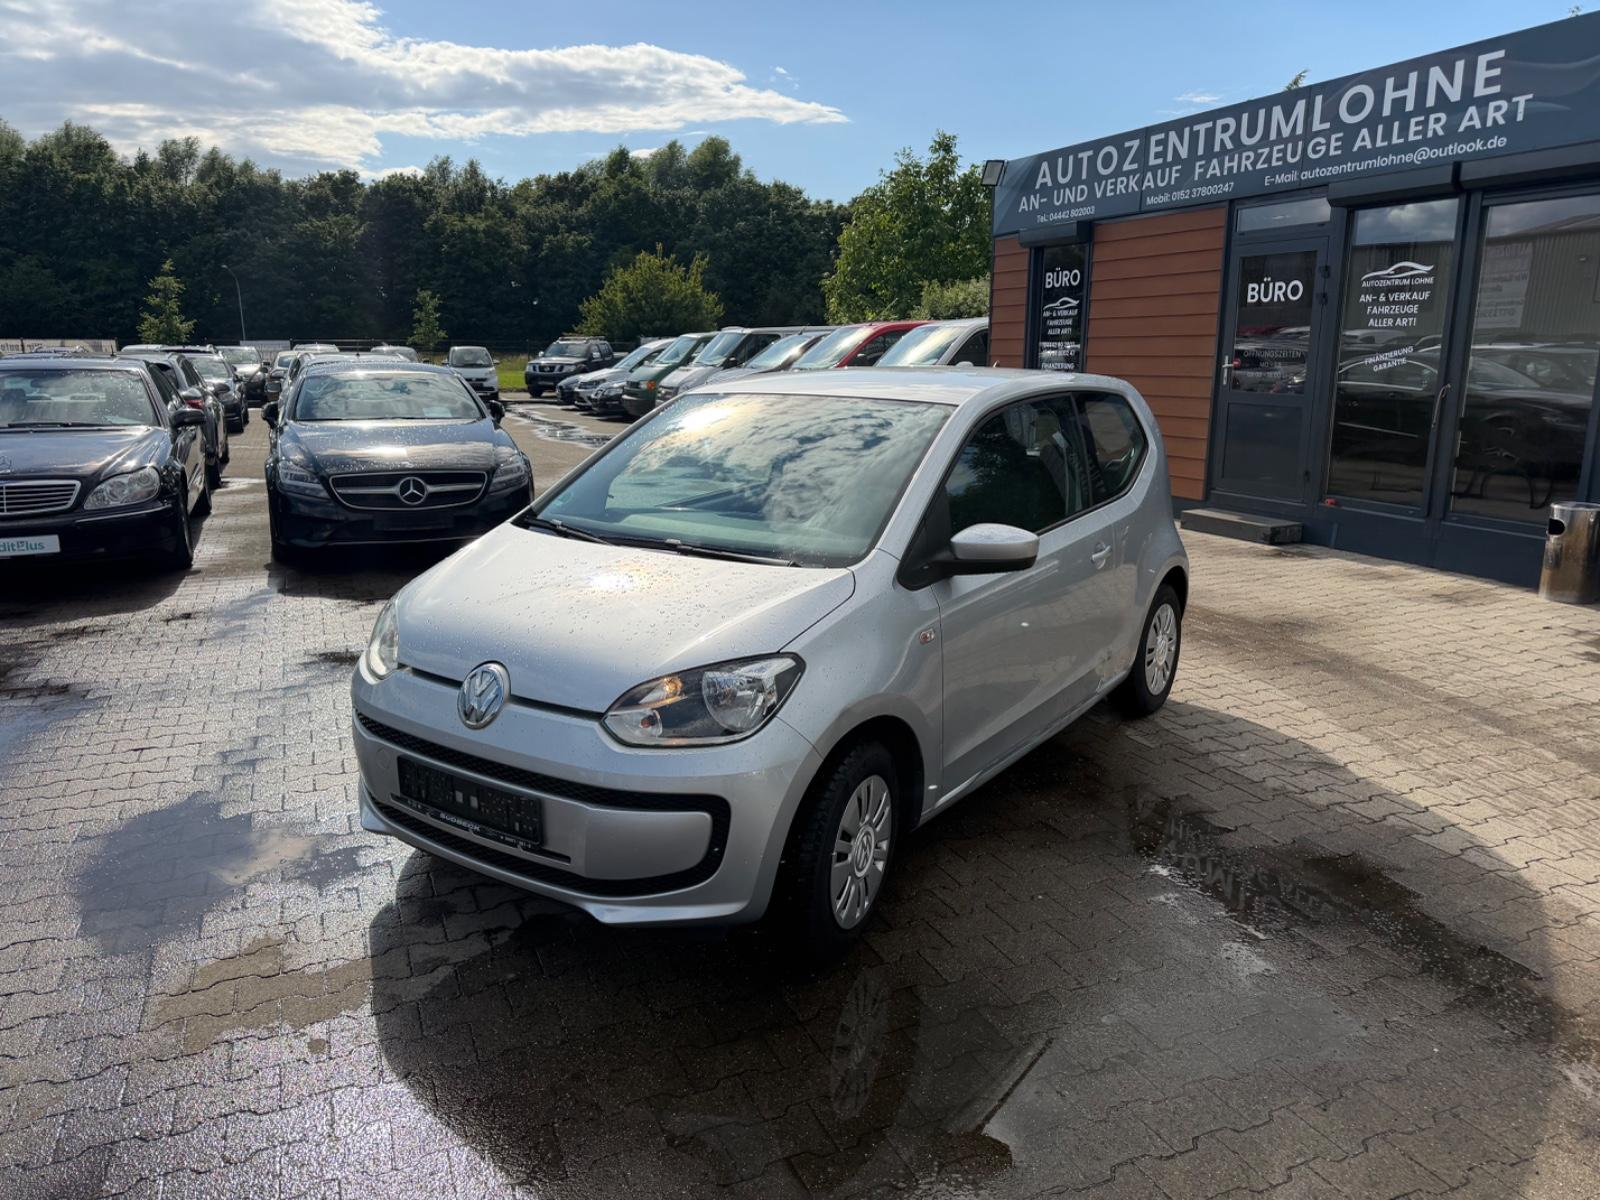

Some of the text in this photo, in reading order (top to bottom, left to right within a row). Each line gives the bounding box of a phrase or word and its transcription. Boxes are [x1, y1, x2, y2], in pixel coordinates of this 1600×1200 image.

[1018, 94, 1533, 213] AN- UND VERKAUF FAHRZEUGE ALLER ART
[1264, 135, 1508, 187] E-Mail: autozentrumlohne@outlook.de
[1146, 181, 1235, 206] Mobil: 0152 37800247
[1050, 209, 1070, 221] 04442
[1070, 205, 1096, 218] 802003
[1045, 267, 1081, 289] BÜRO
[1361, 276, 1435, 288] AUTOZENTRUM LOHNE
[1246, 276, 1304, 303] BÜRO
[1359, 291, 1431, 304] AN- & VERKAUF
[1366, 304, 1419, 315] FAHRZEUGE
[1367, 318, 1394, 328] ALLER
[1364, 345, 1414, 365] FINANZIERUNG
[1373, 357, 1408, 372] GARANTIE
